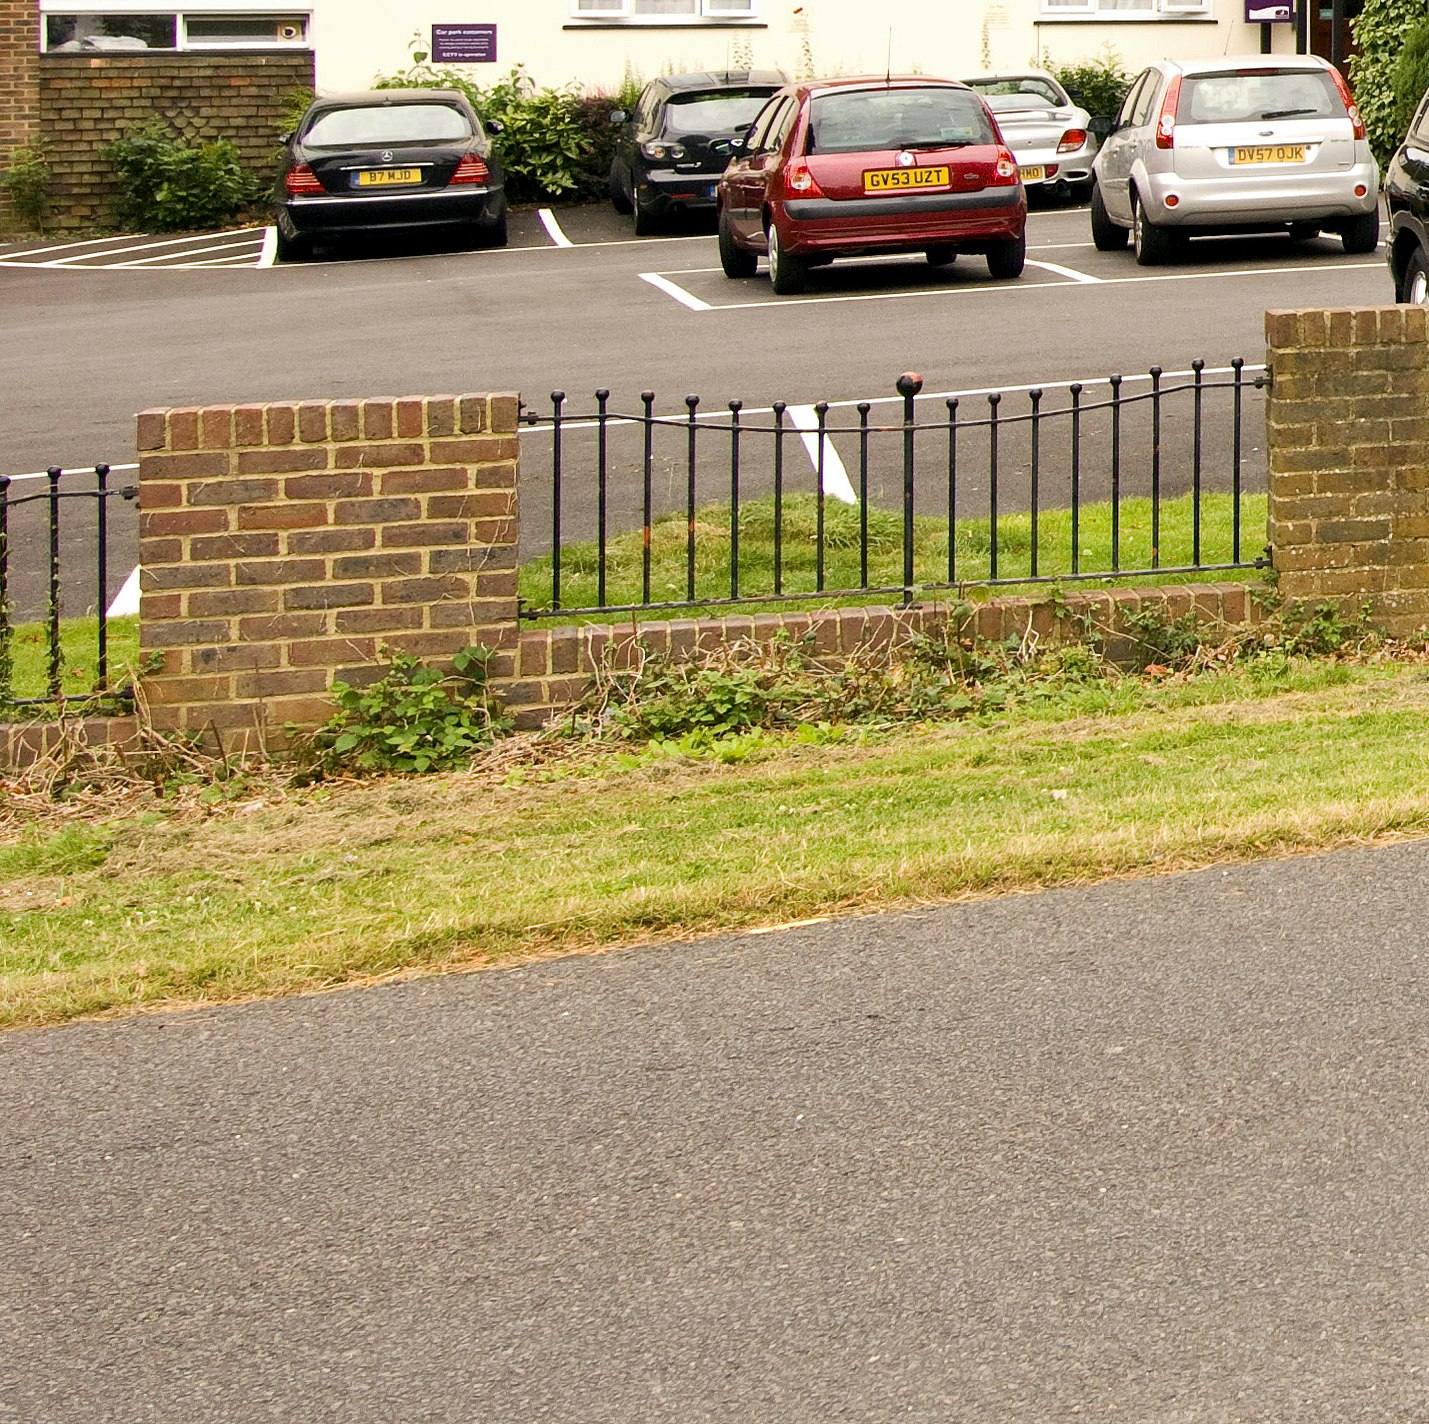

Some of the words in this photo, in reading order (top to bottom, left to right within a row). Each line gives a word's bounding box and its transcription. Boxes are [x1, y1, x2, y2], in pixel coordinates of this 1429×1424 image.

[1238, 147, 1273, 161] DV57
[1277, 146, 1303, 160] OJK
[369, 171, 385, 182] B7
[870, 172, 911, 187] GV53
[914, 169, 942, 184] UZT
